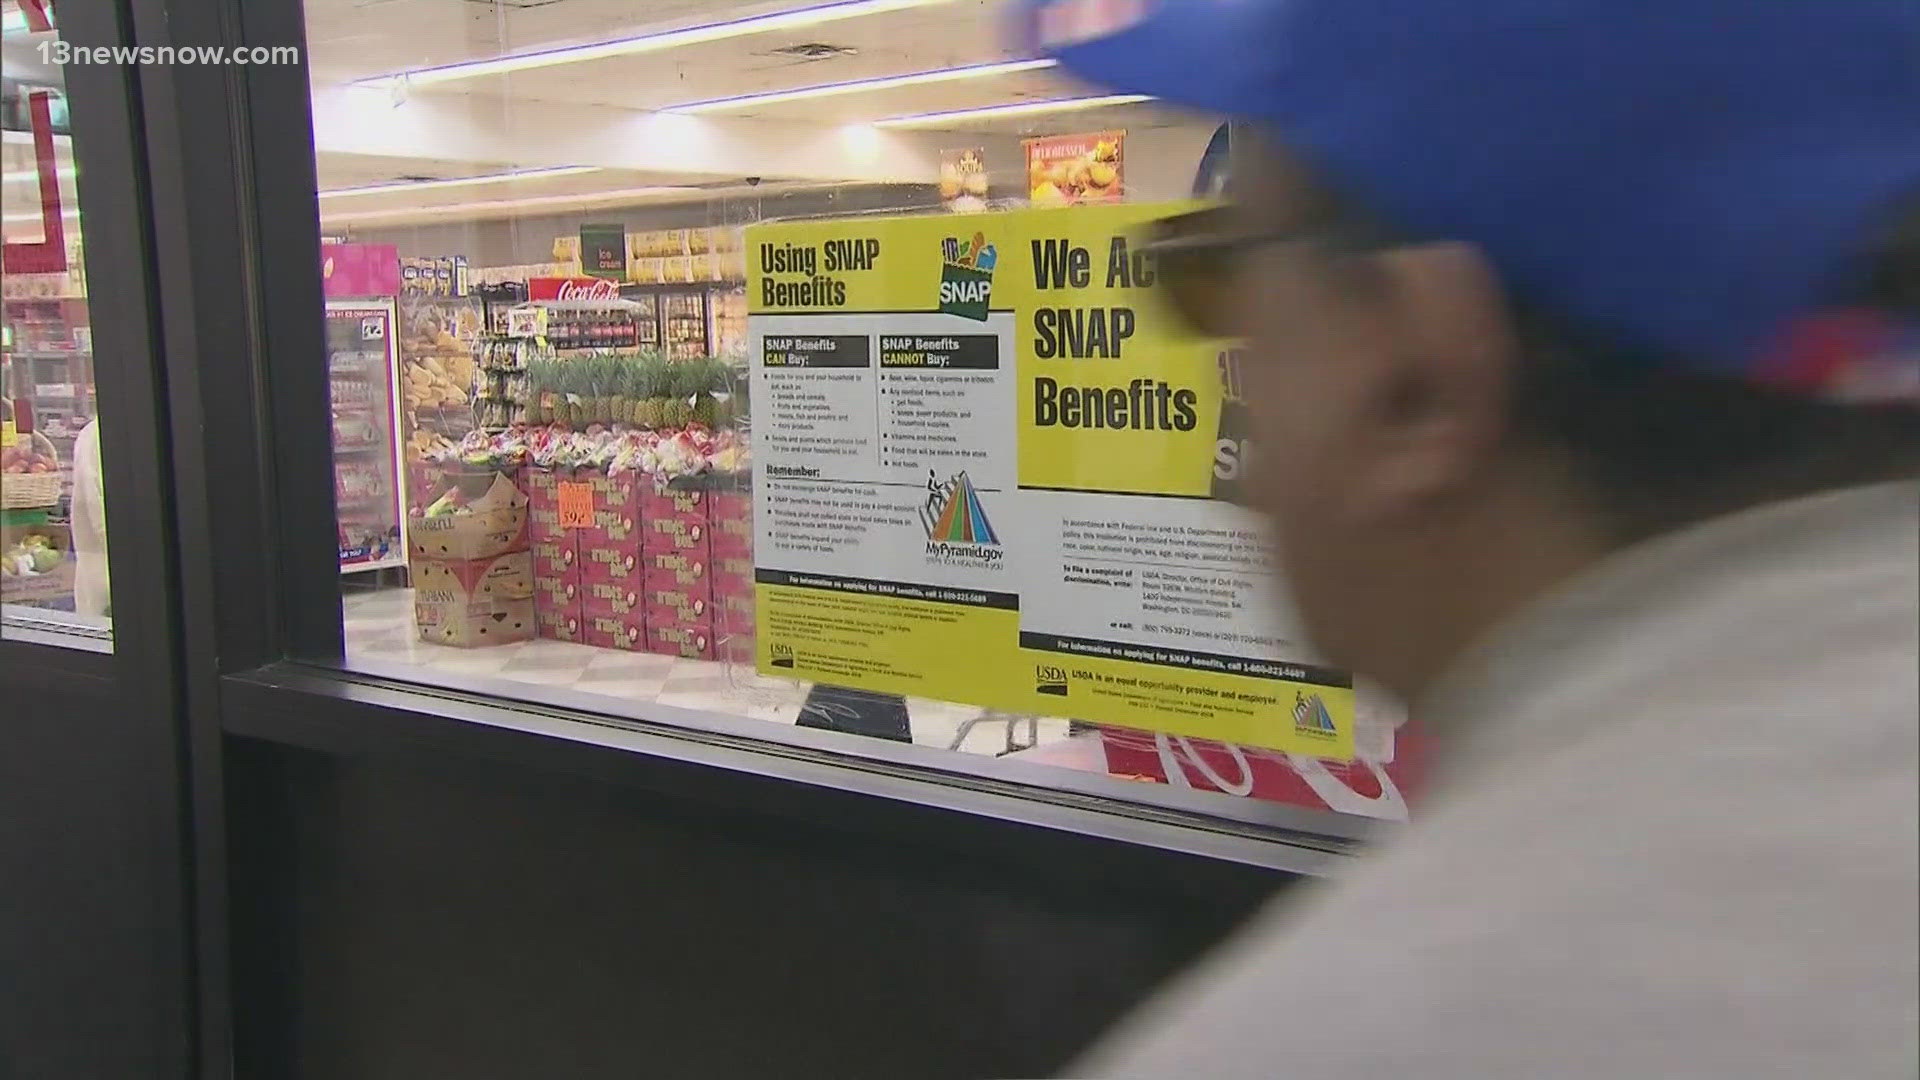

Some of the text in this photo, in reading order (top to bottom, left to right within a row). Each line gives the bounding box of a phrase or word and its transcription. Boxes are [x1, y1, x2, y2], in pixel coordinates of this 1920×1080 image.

[760, 238, 880, 277] Using SNAP
[1031, 239, 1091, 290] We
[761, 276, 847, 307] Benefits
[940, 280, 992, 304] SNAP
[882, 338, 960, 350] SNAP Benefits
[1033, 307, 1136, 359] SNAP
[766, 339, 837, 351] SNAP Benefits
[766, 353, 809, 367] CAN Buy:
[882, 353, 950, 367] CANNOT Buy:
[1034, 377, 1198, 432] Benefits
[766, 463, 820, 478] Remember:
[925, 541, 1004, 563] MyPyramid.gov
[1124, 649, 1155, 662] applying
[1227, 662, 1242, 670] call
[1036, 665, 1068, 681] USDA
[1072, 669, 1094, 681] USDA
[1096, 671, 1103, 681] is
[1104, 674, 1116, 683] an
[1116, 675, 1138, 688] equal
[1139, 678, 1184, 694] opportunity
[1185, 686, 1219, 699] provider
[1220, 688, 1237, 699] and
